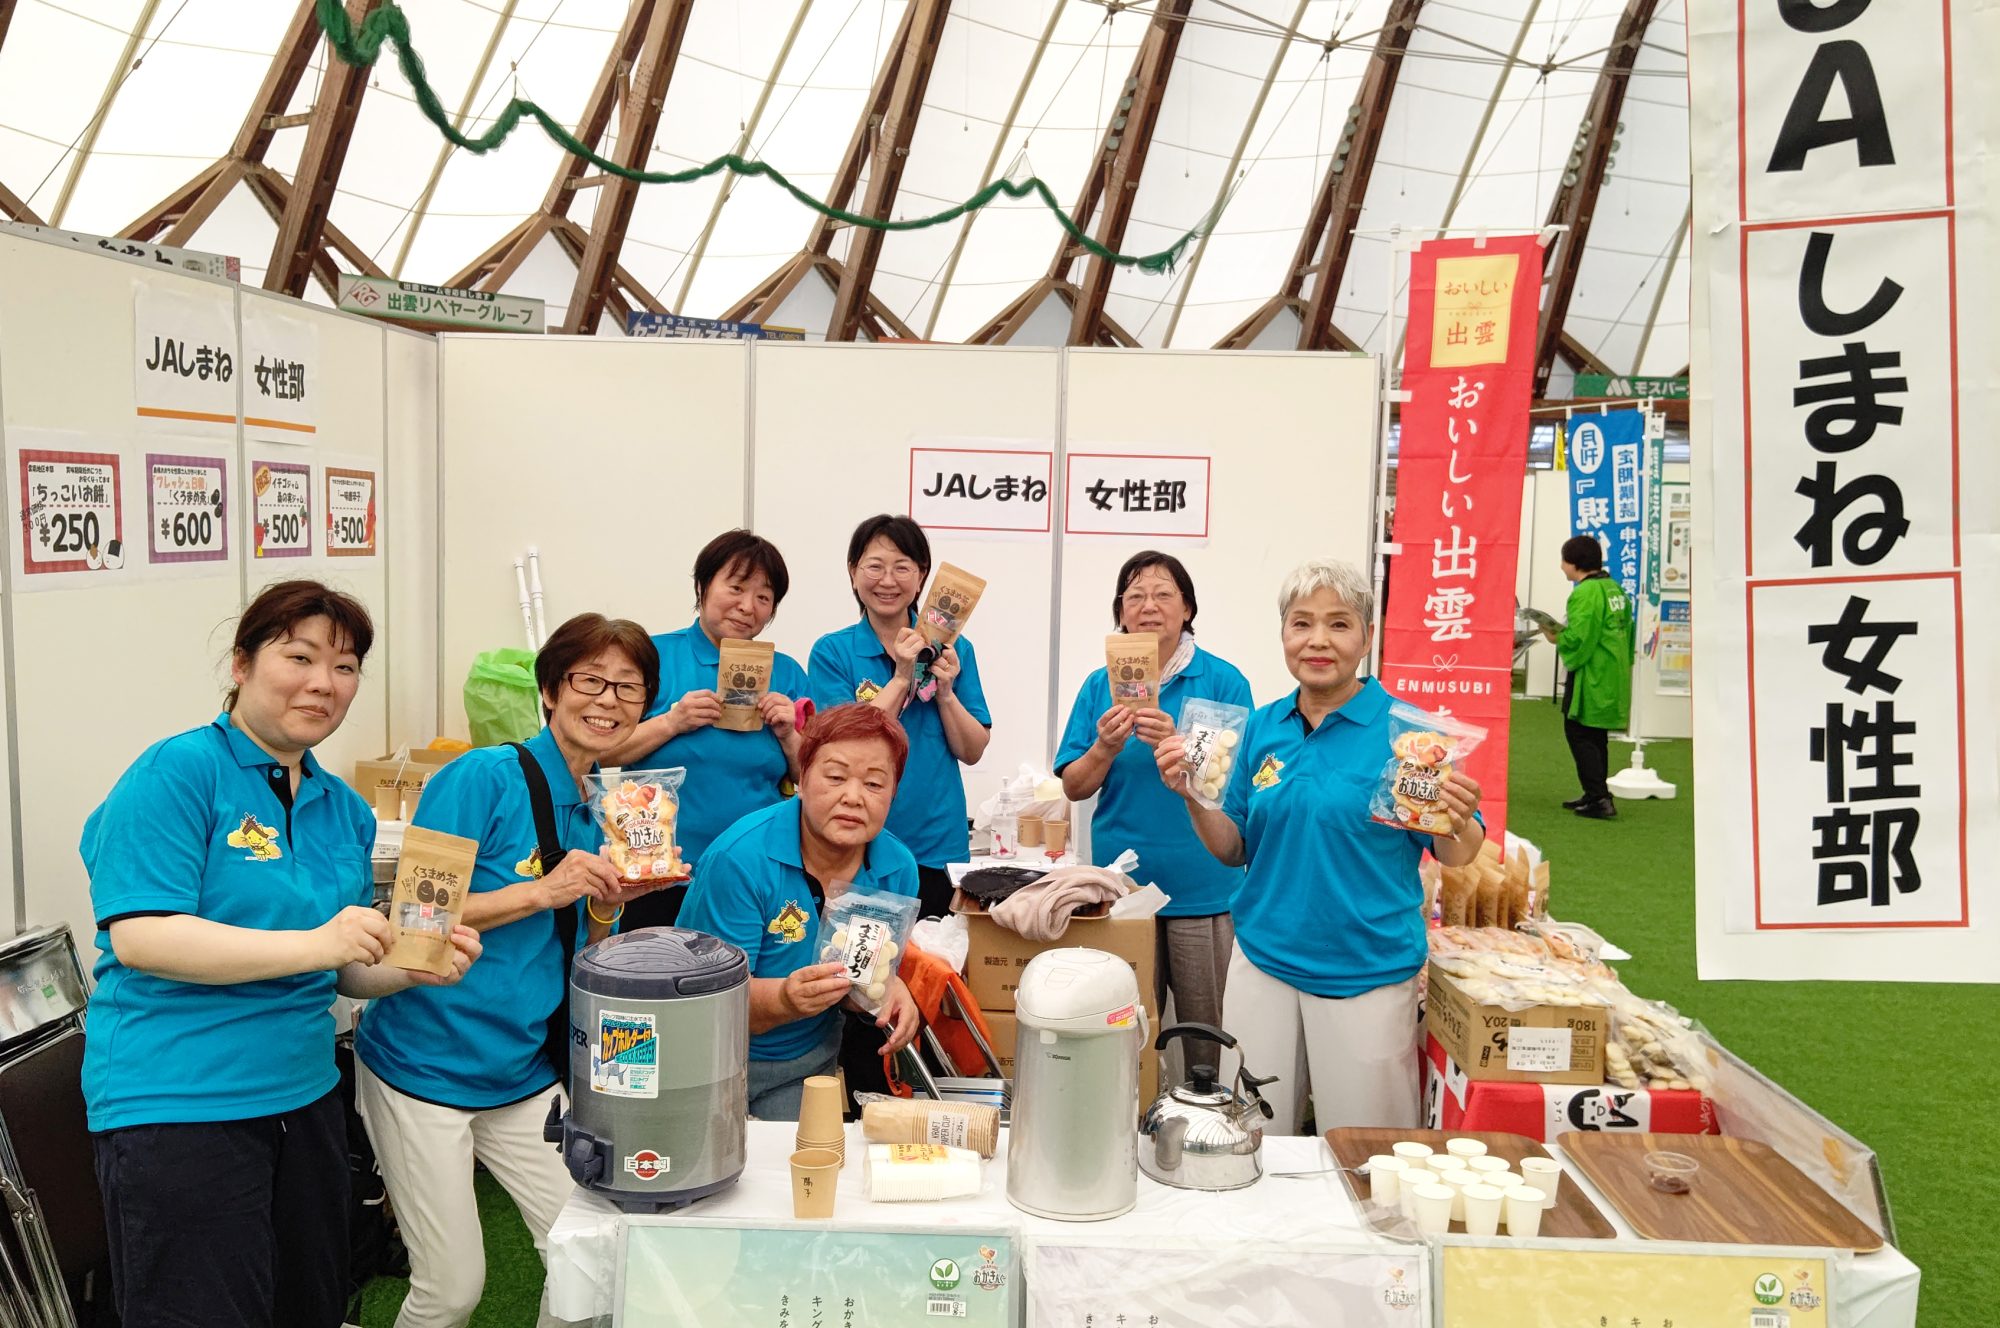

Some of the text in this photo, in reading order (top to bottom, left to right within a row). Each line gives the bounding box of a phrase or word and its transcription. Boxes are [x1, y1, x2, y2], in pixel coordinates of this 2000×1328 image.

[1444, 280, 1508, 296] おいしい
[1446, 320, 1496, 345] 出雲
[146, 336, 305, 402] JAしまね 女性部
[1634, 381, 1689, 396] モスバー
[1765, 0, 1921, 906] Aしまね 女性部
[923, 472, 1187, 513] JAしまね 女性部
[1423, 375, 1485, 642] おいしい出雲
[1397, 679, 1491, 694] ENMUSUBI
[413, 865, 458, 887] くろまめ茶
[984, 957, 1008, 967] 製造元
[931, 1121, 941, 1139] KRAFT
[941, 1114, 951, 1146] PAPER CUP
[627, 1159, 667, 1170] 日本製
